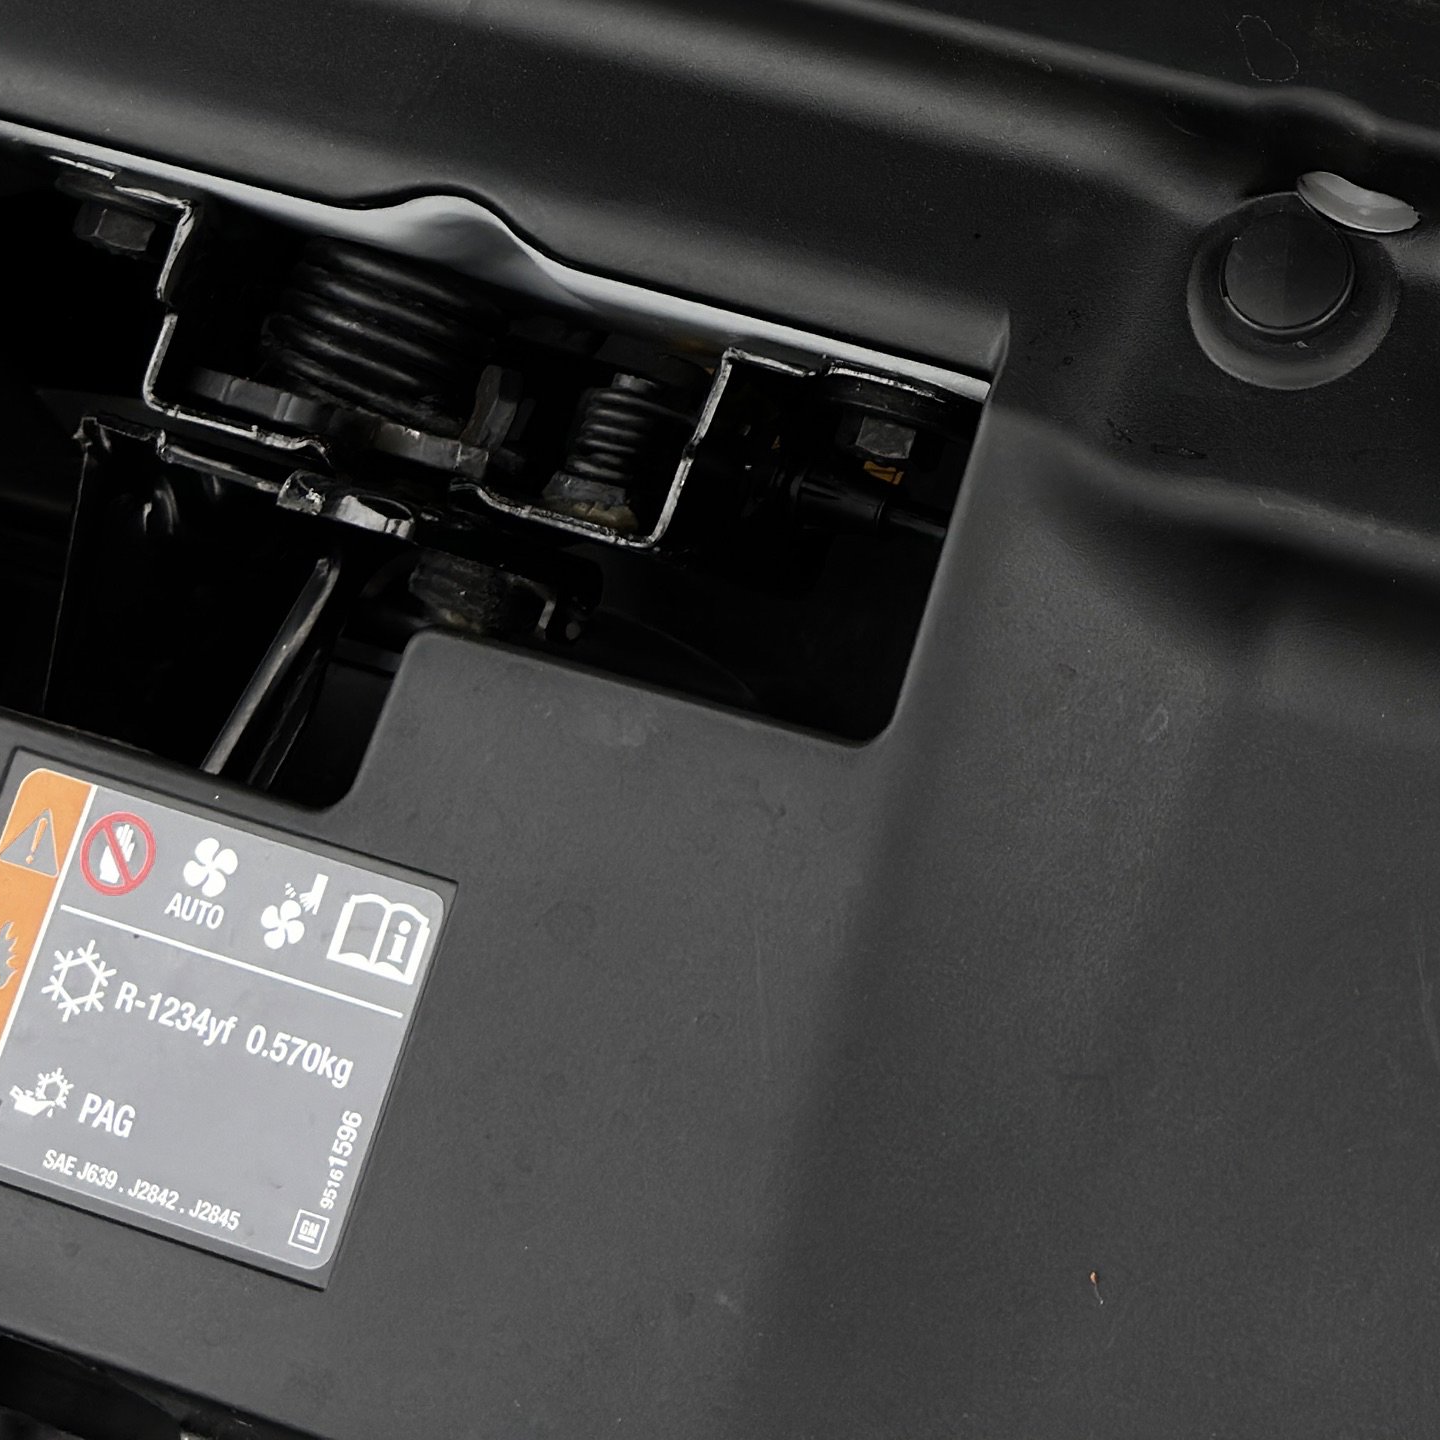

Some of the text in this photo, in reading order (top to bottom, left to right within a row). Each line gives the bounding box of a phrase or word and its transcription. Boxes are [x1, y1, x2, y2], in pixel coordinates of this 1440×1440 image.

[164, 891, 225, 931] AUTO
[113, 980, 355, 1089] R-1234yf 0.570kg
[77, 1092, 136, 1138] PAG
[42, 1149, 241, 1231] SAE J639 J2842 J2845
[319, 1109, 363, 1210] 95161596
[298, 1220, 320, 1240] GM
